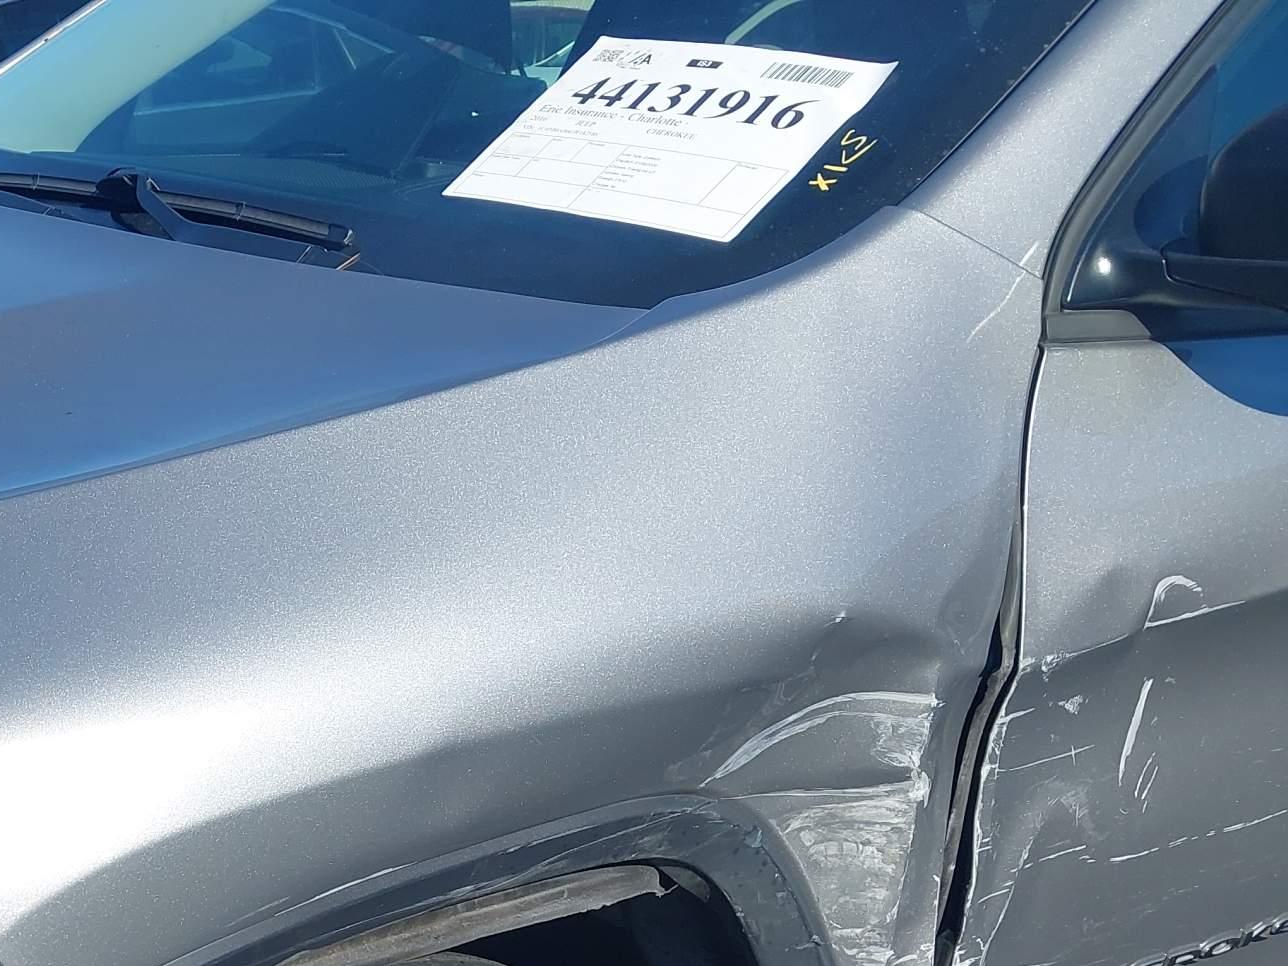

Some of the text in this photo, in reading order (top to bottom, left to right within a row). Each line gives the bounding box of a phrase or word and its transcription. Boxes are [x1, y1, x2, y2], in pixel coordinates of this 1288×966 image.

[539, 104, 563, 114] Erie
[564, 105, 619, 120] Insurance
[628, 111, 683, 128] Charlotte
[571, 76, 821, 130] 44131916
